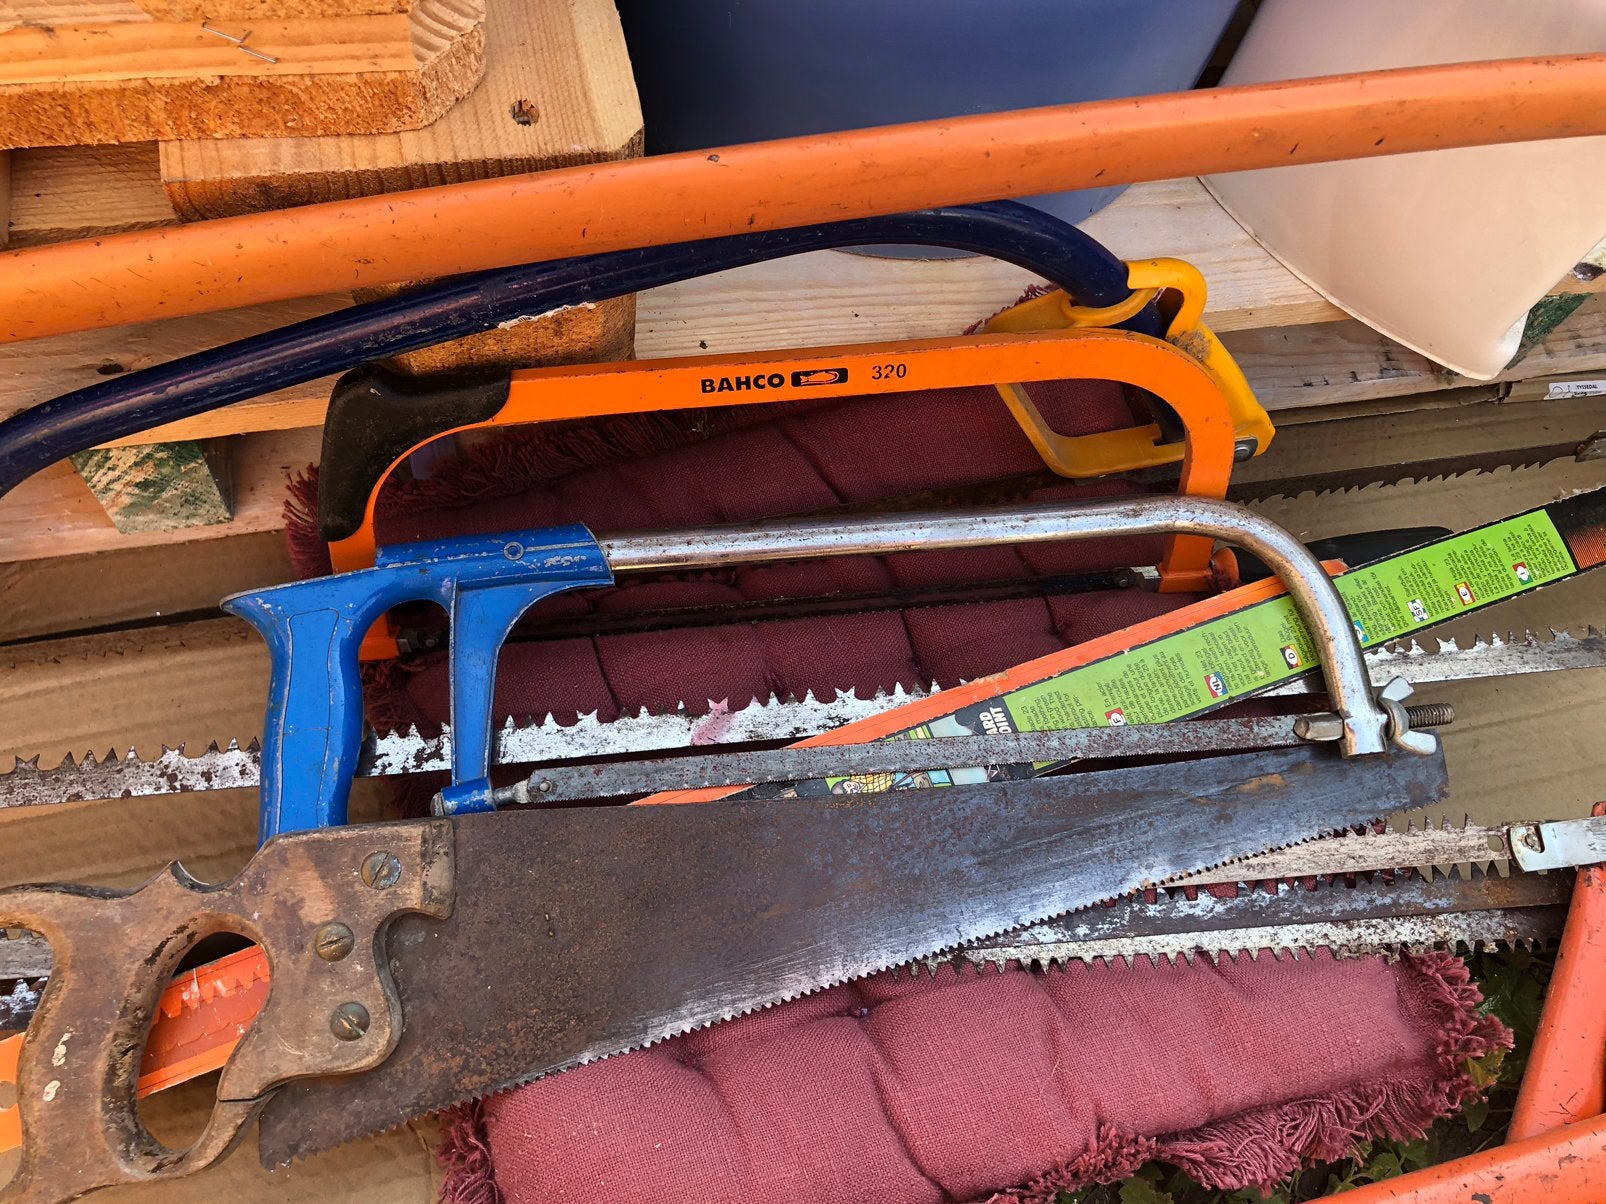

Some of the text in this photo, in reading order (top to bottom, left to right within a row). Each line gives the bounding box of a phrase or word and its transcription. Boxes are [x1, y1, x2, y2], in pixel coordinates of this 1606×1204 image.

[700, 363, 907, 394] BAHCO 320
[977, 710, 998, 736] ARD
[988, 703, 1012, 735] OINT
[1025, 715, 1036, 730] lade
[1067, 702, 1082, 727] ustproof
[1078, 707, 1091, 727] asting
